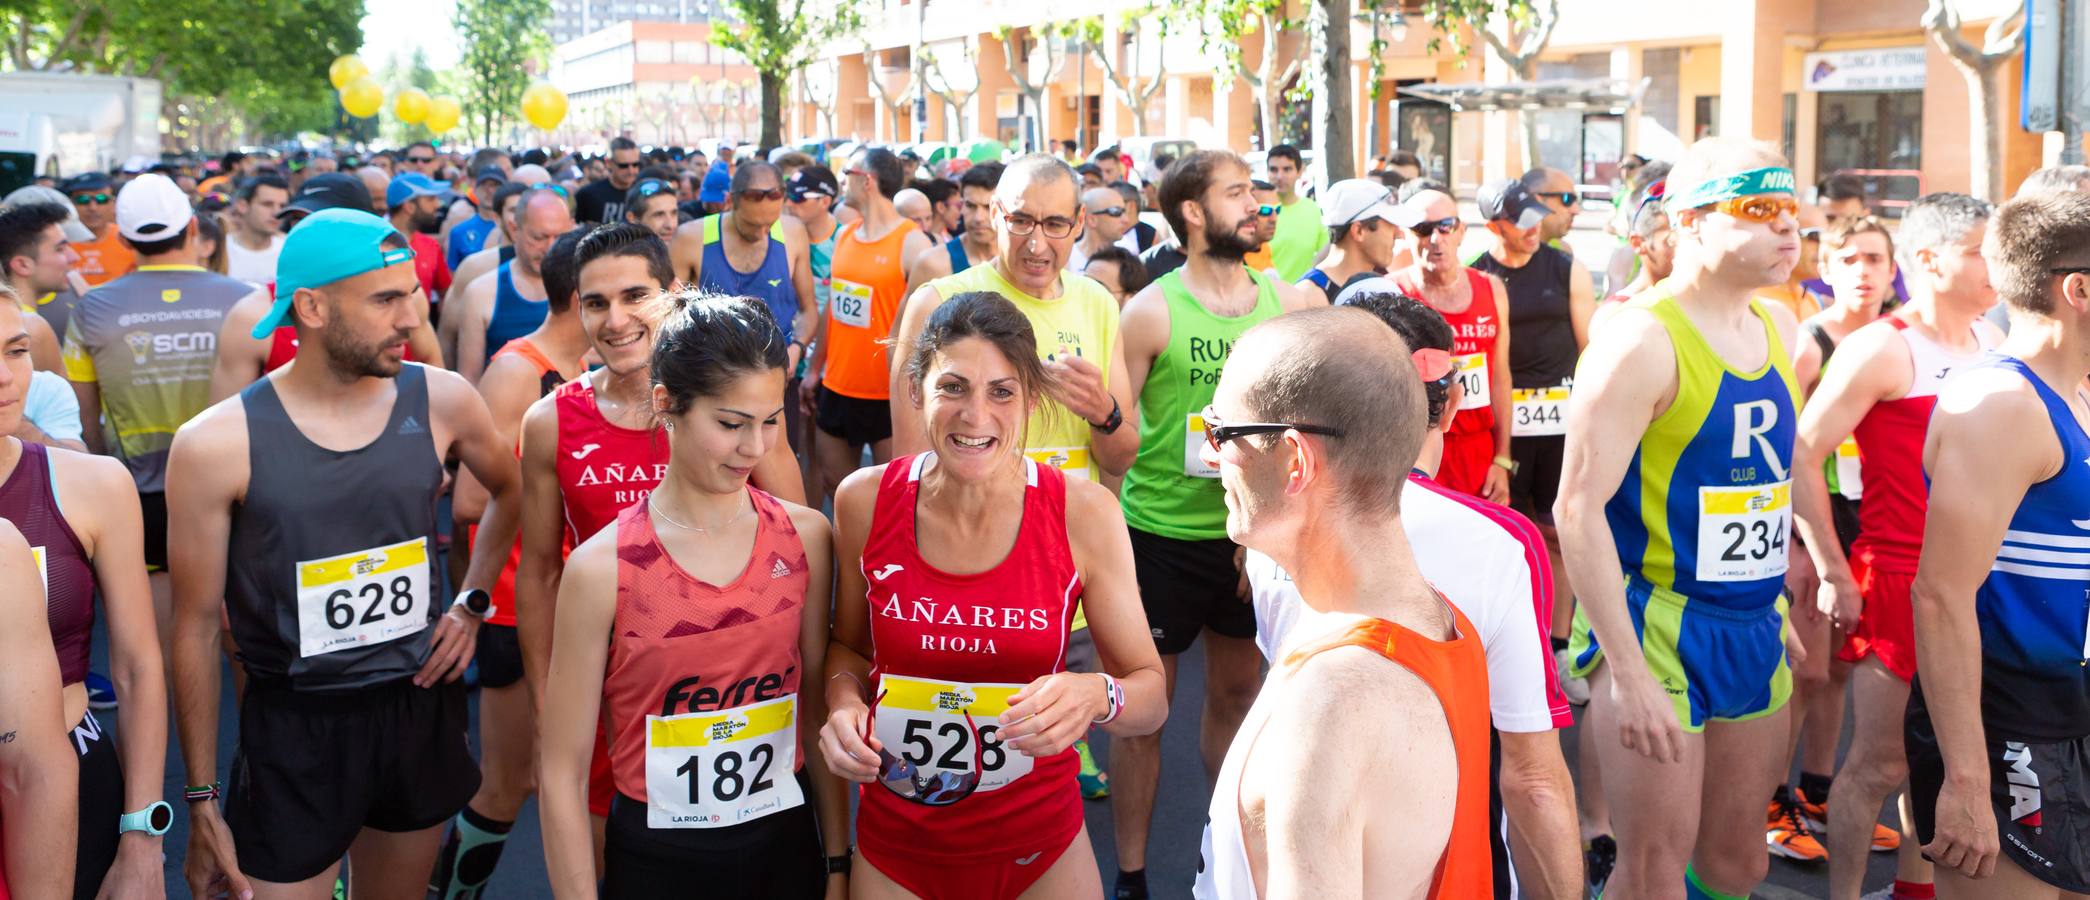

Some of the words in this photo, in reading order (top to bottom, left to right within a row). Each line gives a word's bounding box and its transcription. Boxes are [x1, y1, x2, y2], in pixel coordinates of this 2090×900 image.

[836, 295, 862, 317] 162
[1058, 331, 1080, 344] RUN
[1517, 404, 1561, 425] 344
[1731, 398, 1790, 481] R
[1731, 466, 1757, 482] CLUB
[1720, 514, 1785, 561] 234
[325, 575, 414, 630] 628
[880, 592, 1049, 631] AÑARES
[921, 634, 998, 655] RIOJA
[712, 721, 747, 732] MARATÓN
[902, 718, 1006, 771] 528
[676, 742, 774, 805] 182
[2003, 741, 2042, 821] MA
